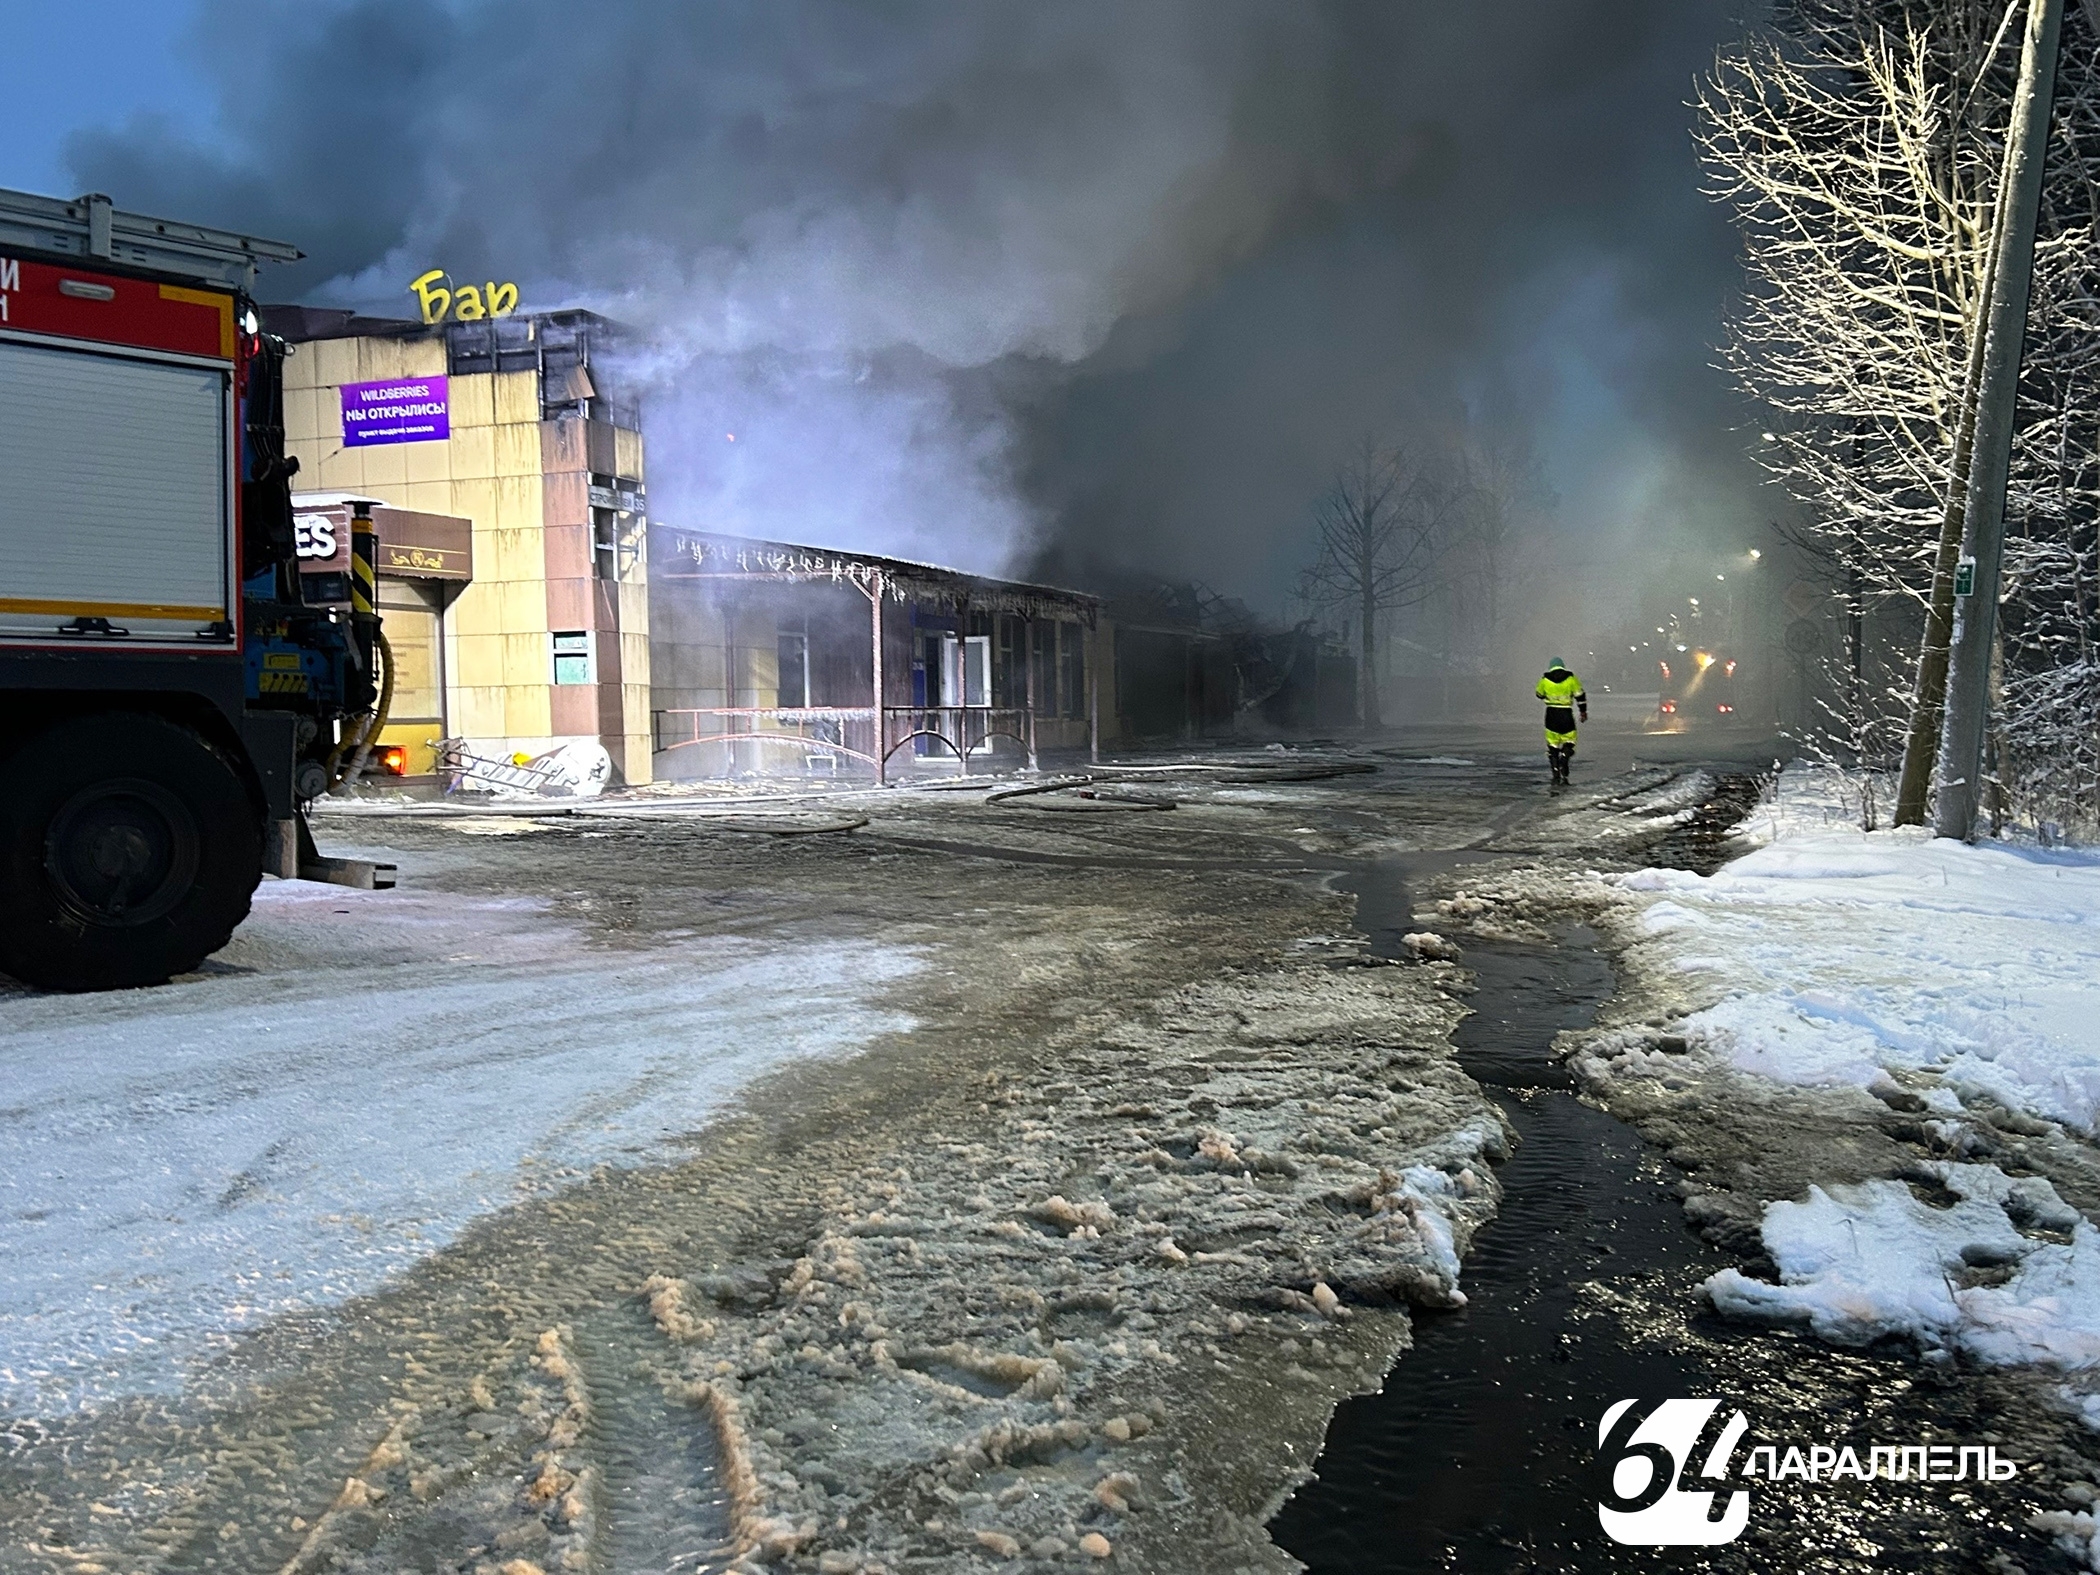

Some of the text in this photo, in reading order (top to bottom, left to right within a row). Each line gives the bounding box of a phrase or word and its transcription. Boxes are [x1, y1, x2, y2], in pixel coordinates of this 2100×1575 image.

[409, 269, 519, 325] Бар
[360, 385, 430, 401] WILDBERRIES
[367, 402, 446, 420] ОТКРЫЛИСЬ!
